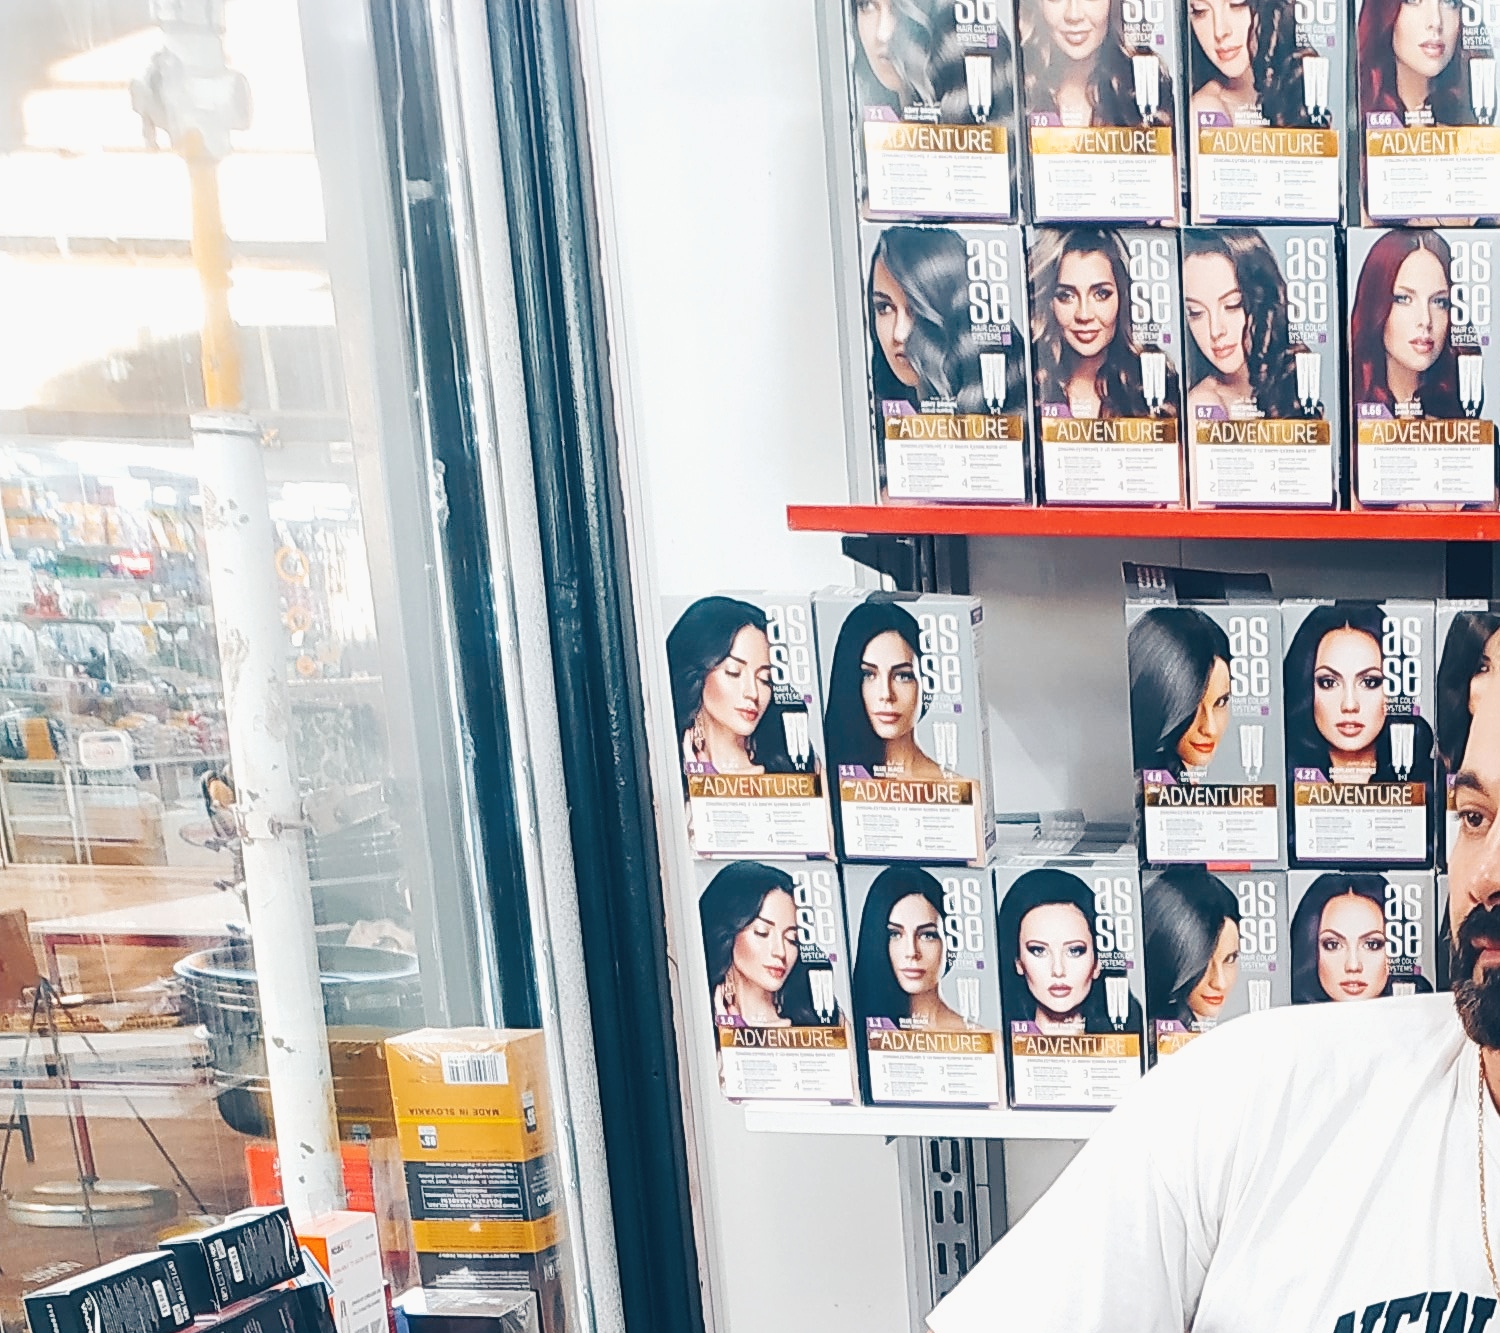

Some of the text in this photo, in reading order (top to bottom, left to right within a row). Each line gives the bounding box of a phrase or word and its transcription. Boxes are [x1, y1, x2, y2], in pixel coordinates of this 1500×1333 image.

[1212, 131, 1324, 155] ADVENTURE
[899, 417, 1009, 441] ADVENTURE
[1211, 421, 1318, 444] ADVENTURE
[1372, 421, 1481, 444] ADVENTURE
[702, 776, 811, 798] ADVENTURE
[853, 782, 961, 804] ADVENTURE
[1305, 785, 1413, 806] ADVENTURE
[732, 1027, 834, 1049] ADVENTURE
